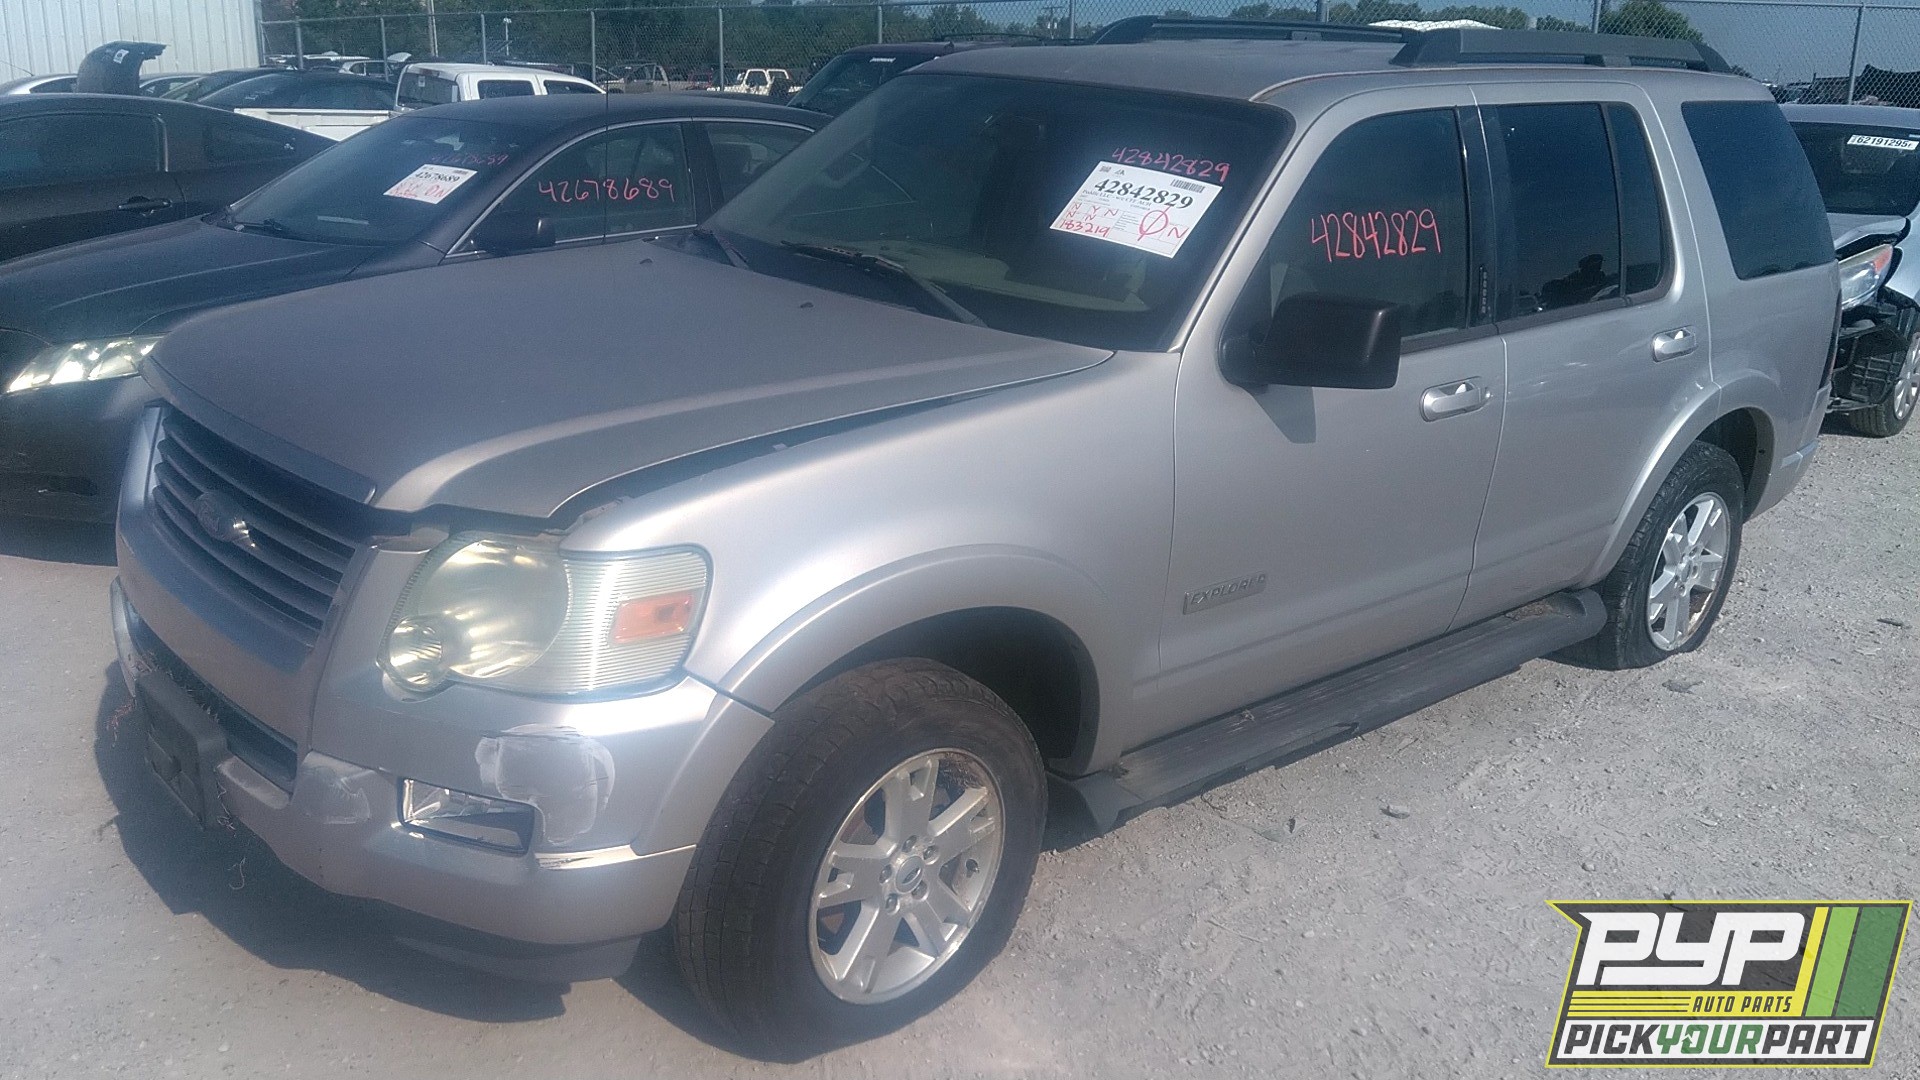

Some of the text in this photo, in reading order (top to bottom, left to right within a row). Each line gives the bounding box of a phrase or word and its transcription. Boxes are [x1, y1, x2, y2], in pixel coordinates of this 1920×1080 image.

[1857, 136, 1908, 148] 62191295
[1112, 147, 1230, 182] 42842829
[538, 177, 675, 202] 42678689
[1094, 178, 1193, 209] 42842829
[1311, 208, 1441, 262] 42842829
